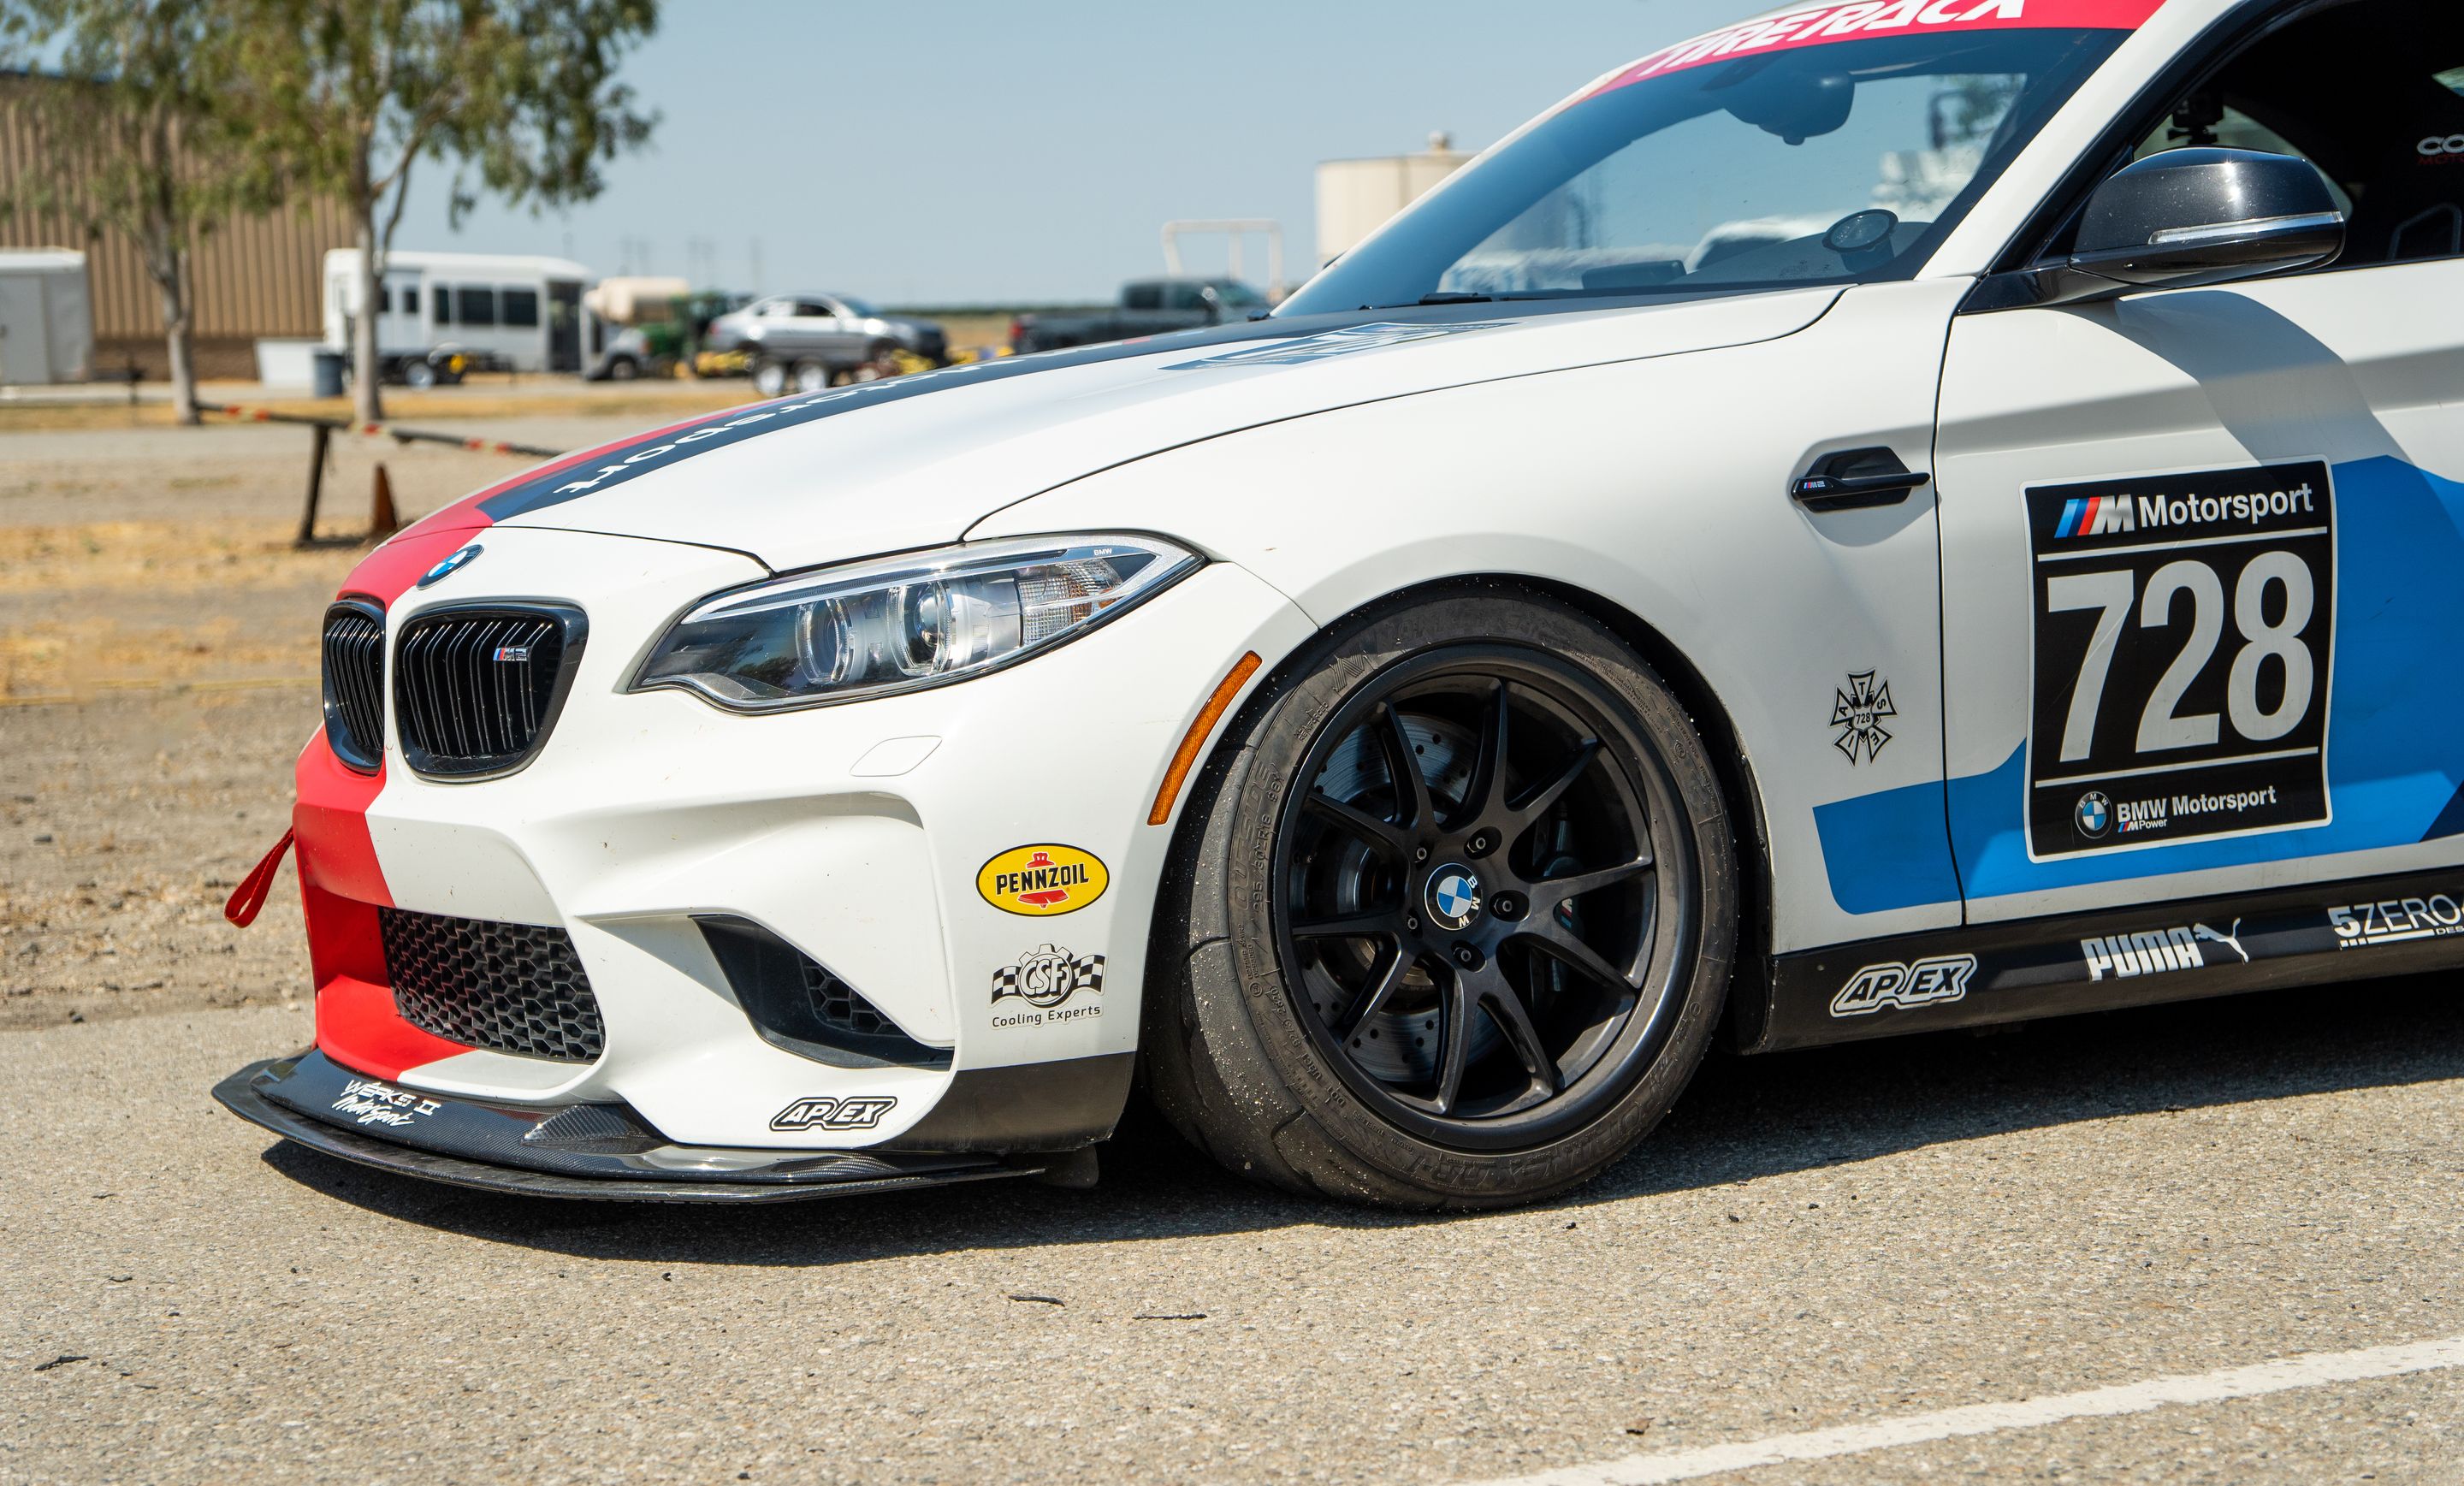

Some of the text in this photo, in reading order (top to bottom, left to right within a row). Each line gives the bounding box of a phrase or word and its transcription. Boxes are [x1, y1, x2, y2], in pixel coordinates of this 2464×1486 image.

[2139, 483, 2313, 528] Motorsport
[2047, 550, 2314, 763] 728
[1856, 713, 1871, 725] 728
[2118, 785, 2276, 823] BMW Motorsport
[996, 863, 1089, 895] PENNZOIL
[2328, 894, 2464, 938] 5ZERO
[2081, 927, 2204, 983] PUMA
[1025, 957, 1070, 998] CSF
[1838, 960, 1970, 1010] APEX
[992, 1005, 1100, 1027] Cooling Experts
[775, 1100, 891, 1127] APEX
